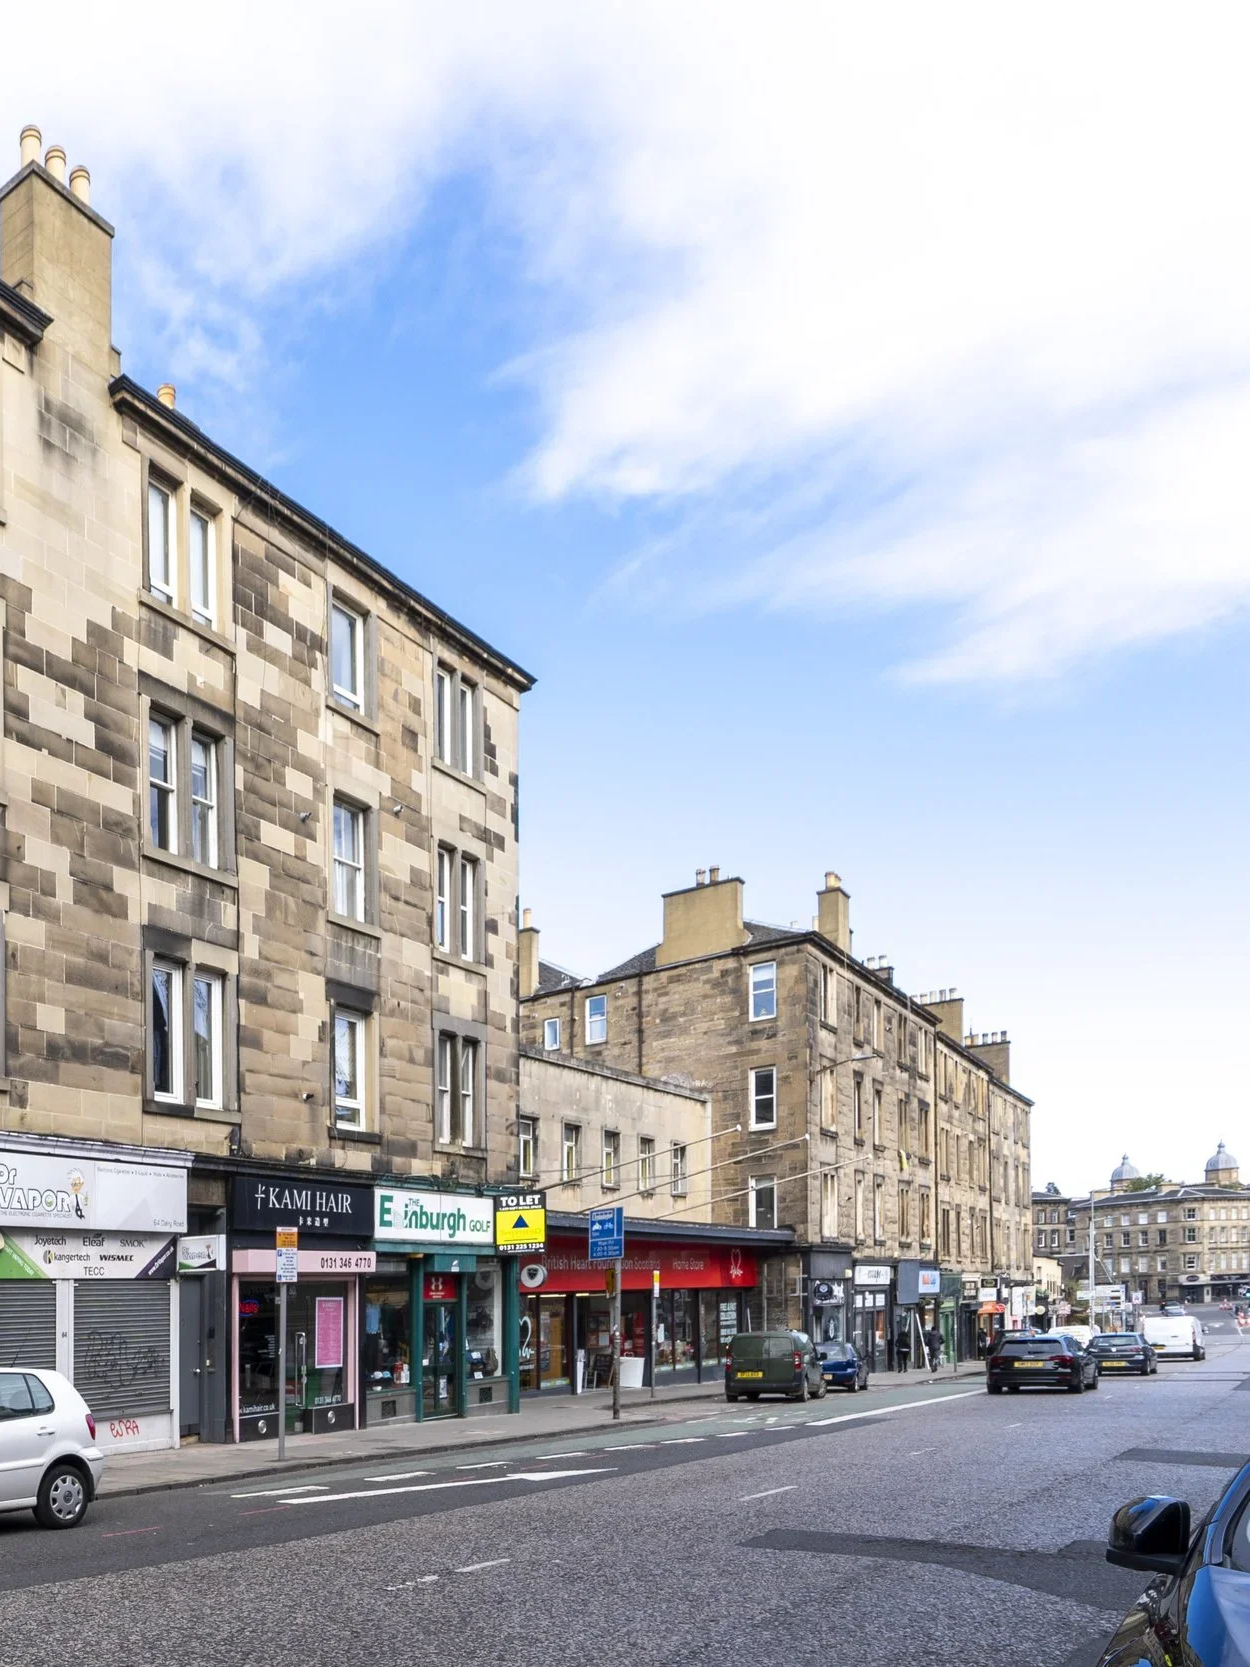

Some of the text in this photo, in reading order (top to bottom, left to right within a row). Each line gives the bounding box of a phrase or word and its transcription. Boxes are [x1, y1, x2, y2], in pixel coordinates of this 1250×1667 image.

[268, 1187, 353, 1214] KAMI HAIR
[408, 1197, 420, 1207] THE
[500, 1194, 541, 1207] TO LET
[173, 1220, 185, 1228] Road
[468, 1219, 491, 1233] GOLF
[34, 1234, 146, 1248] Joyetech Eleaf SMOK
[54, 1253, 91, 1264] kangertech
[99, 1254, 134, 1262] WISMEC
[320, 1257, 372, 1269] 0131 346 4770
[542, 1254, 569, 1270] British
[570, 1257, 592, 1270] Heart
[672, 1258, 689, 1270] Home
[689, 1259, 704, 1270] Store
[83, 1266, 105, 1276] TECC
